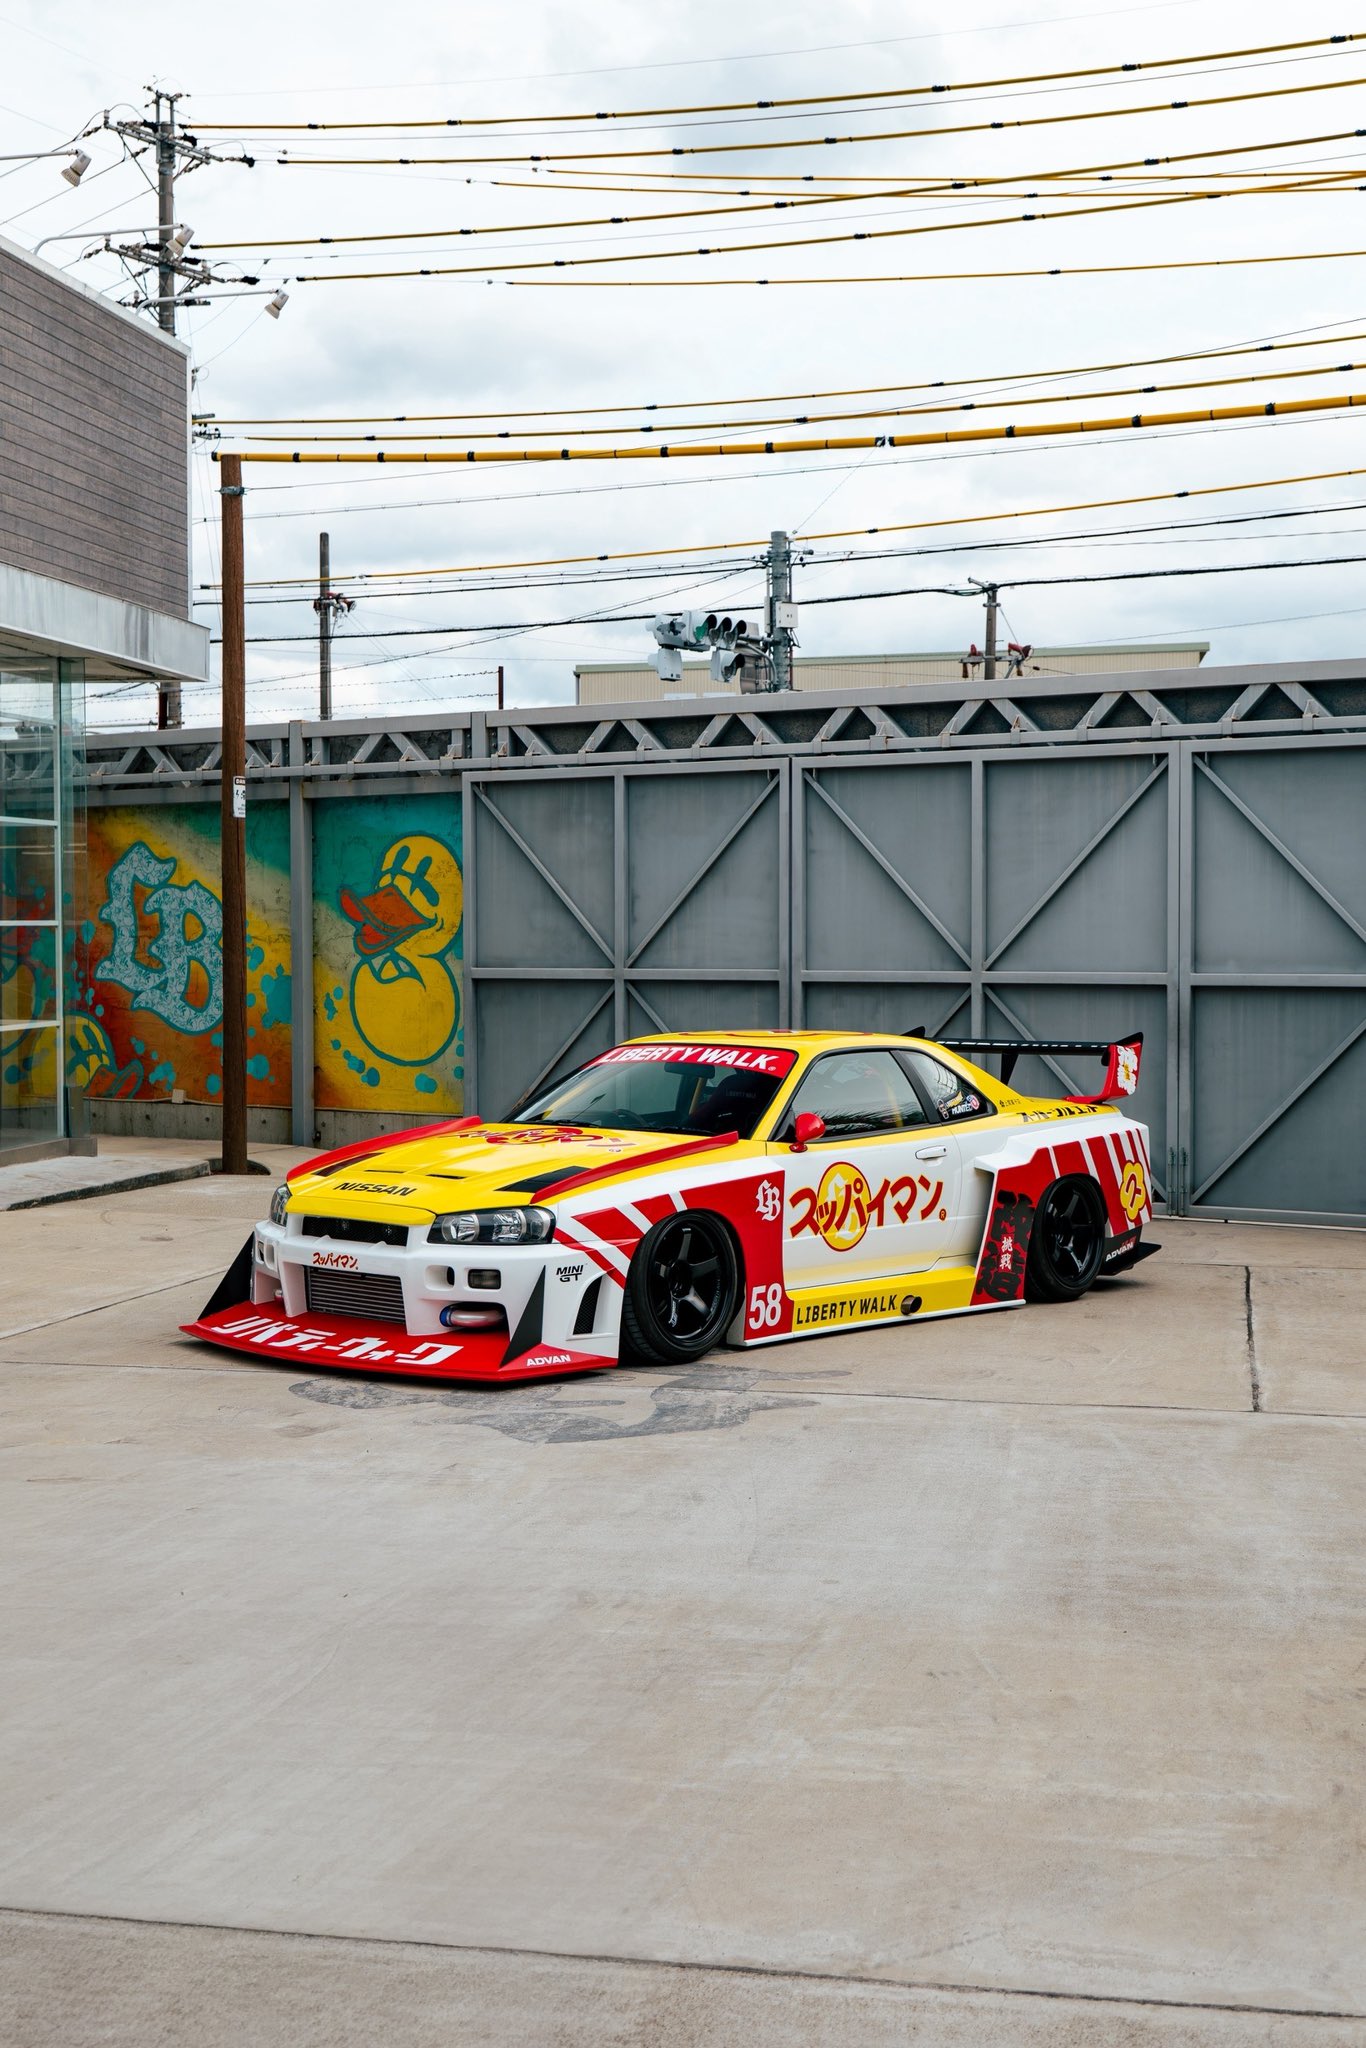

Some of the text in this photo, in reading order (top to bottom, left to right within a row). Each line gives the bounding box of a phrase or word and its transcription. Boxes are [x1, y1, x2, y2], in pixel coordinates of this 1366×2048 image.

[603, 1047, 779, 1070] LIBERTY WALK
[333, 1182, 417, 1196] NISSAN
[789, 1174, 944, 1238] スッパイマン
[1105, 1242, 1134, 1262] ADVAN
[556, 1265, 584, 1275] MINI
[560, 1273, 582, 1282] GT
[748, 1283, 783, 1330] 58
[796, 1294, 898, 1325] LIBERTY WALK
[526, 1354, 572, 1367] ADVAN
